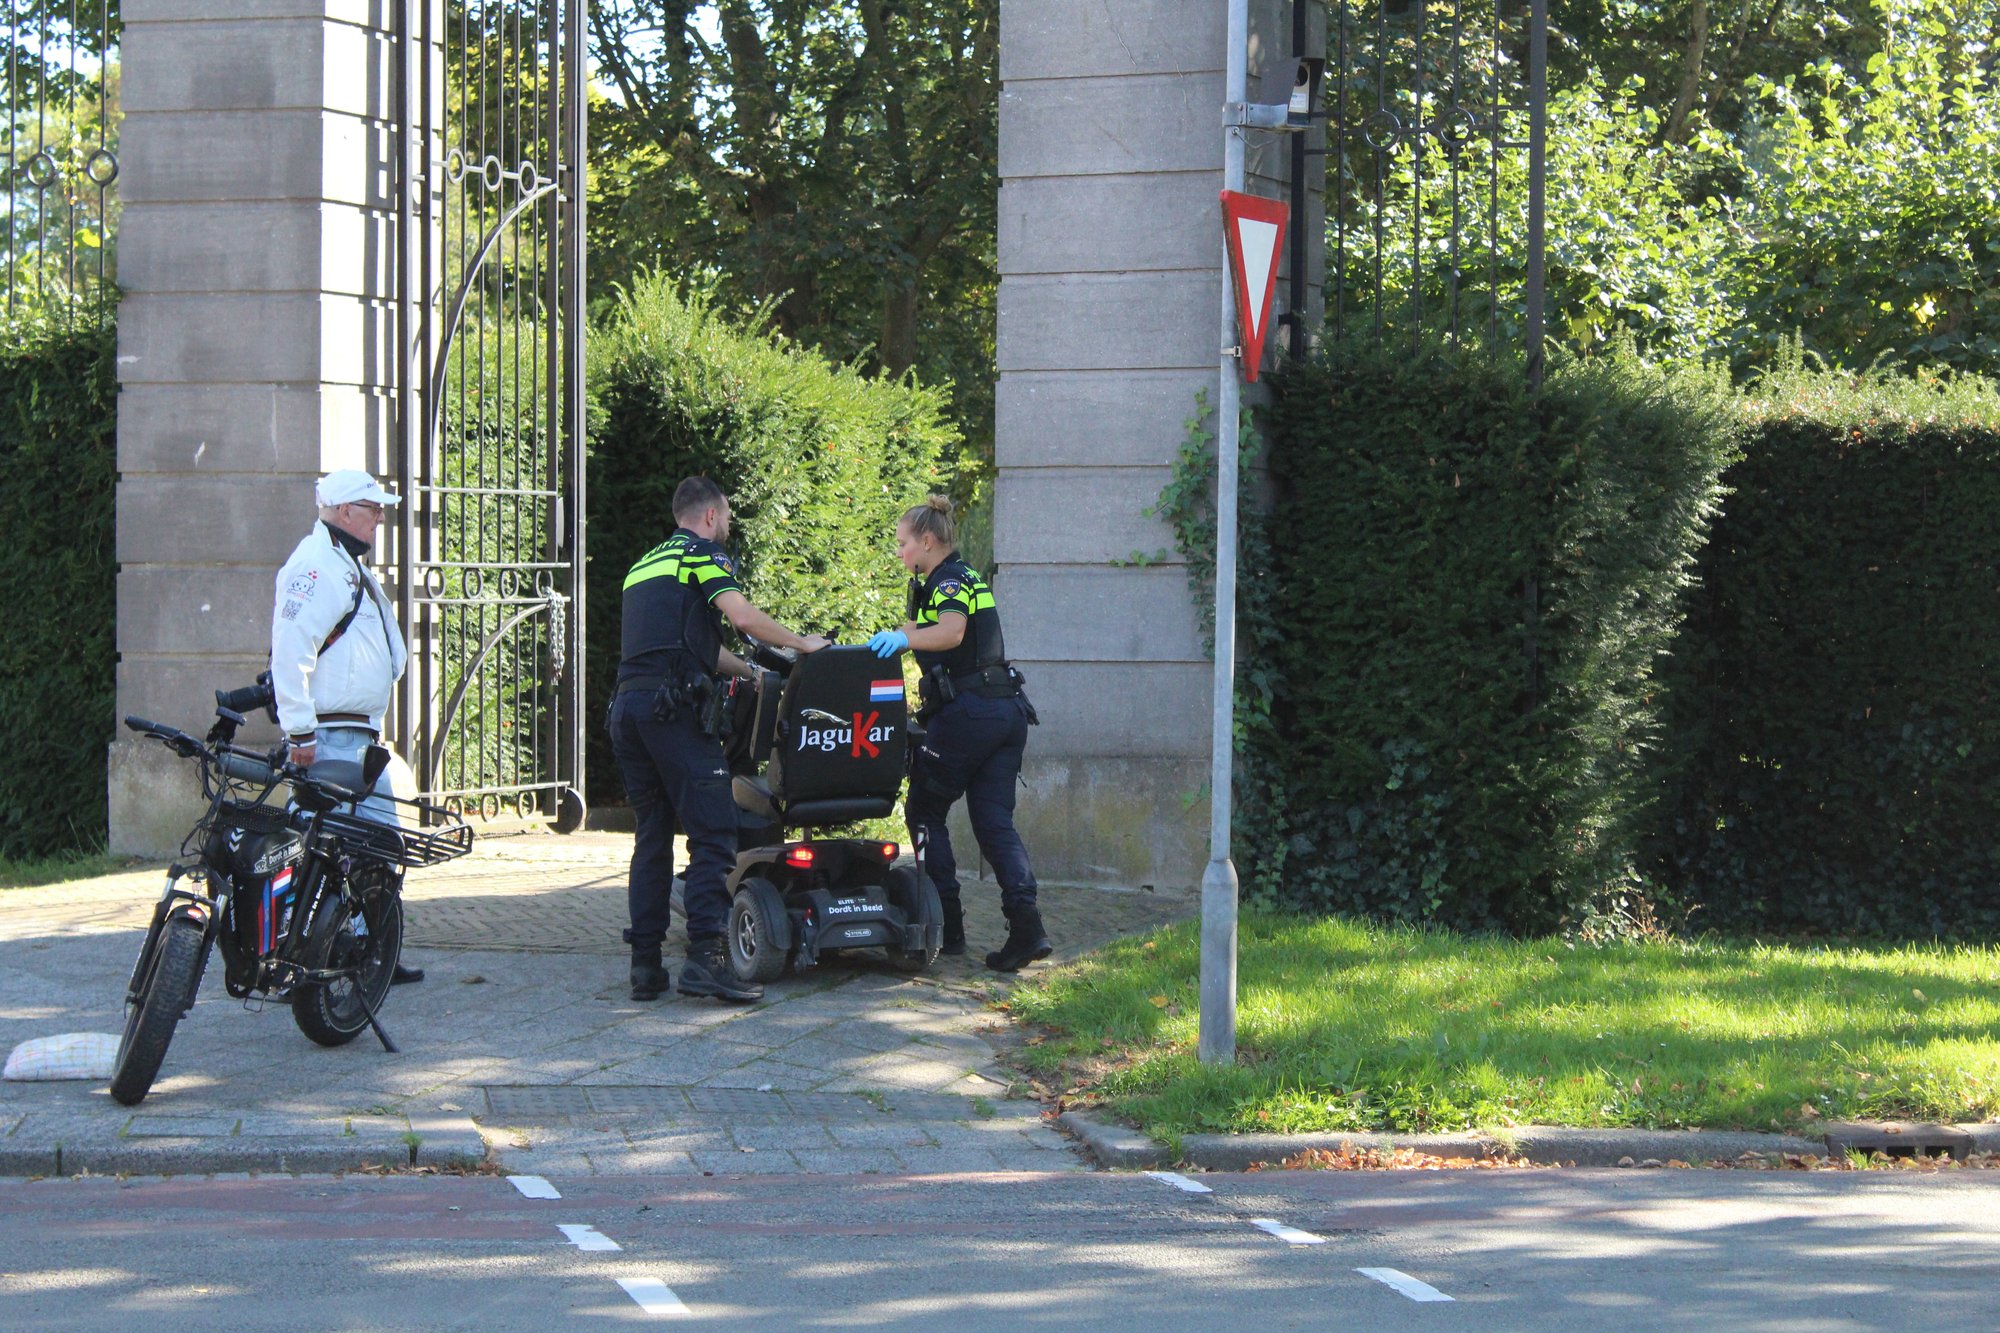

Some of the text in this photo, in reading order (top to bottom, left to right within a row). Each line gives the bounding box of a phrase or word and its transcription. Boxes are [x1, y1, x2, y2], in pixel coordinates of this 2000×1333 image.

[798, 711, 895, 758] JaguKar
[828, 904, 883, 914] Dordt in Beeld
